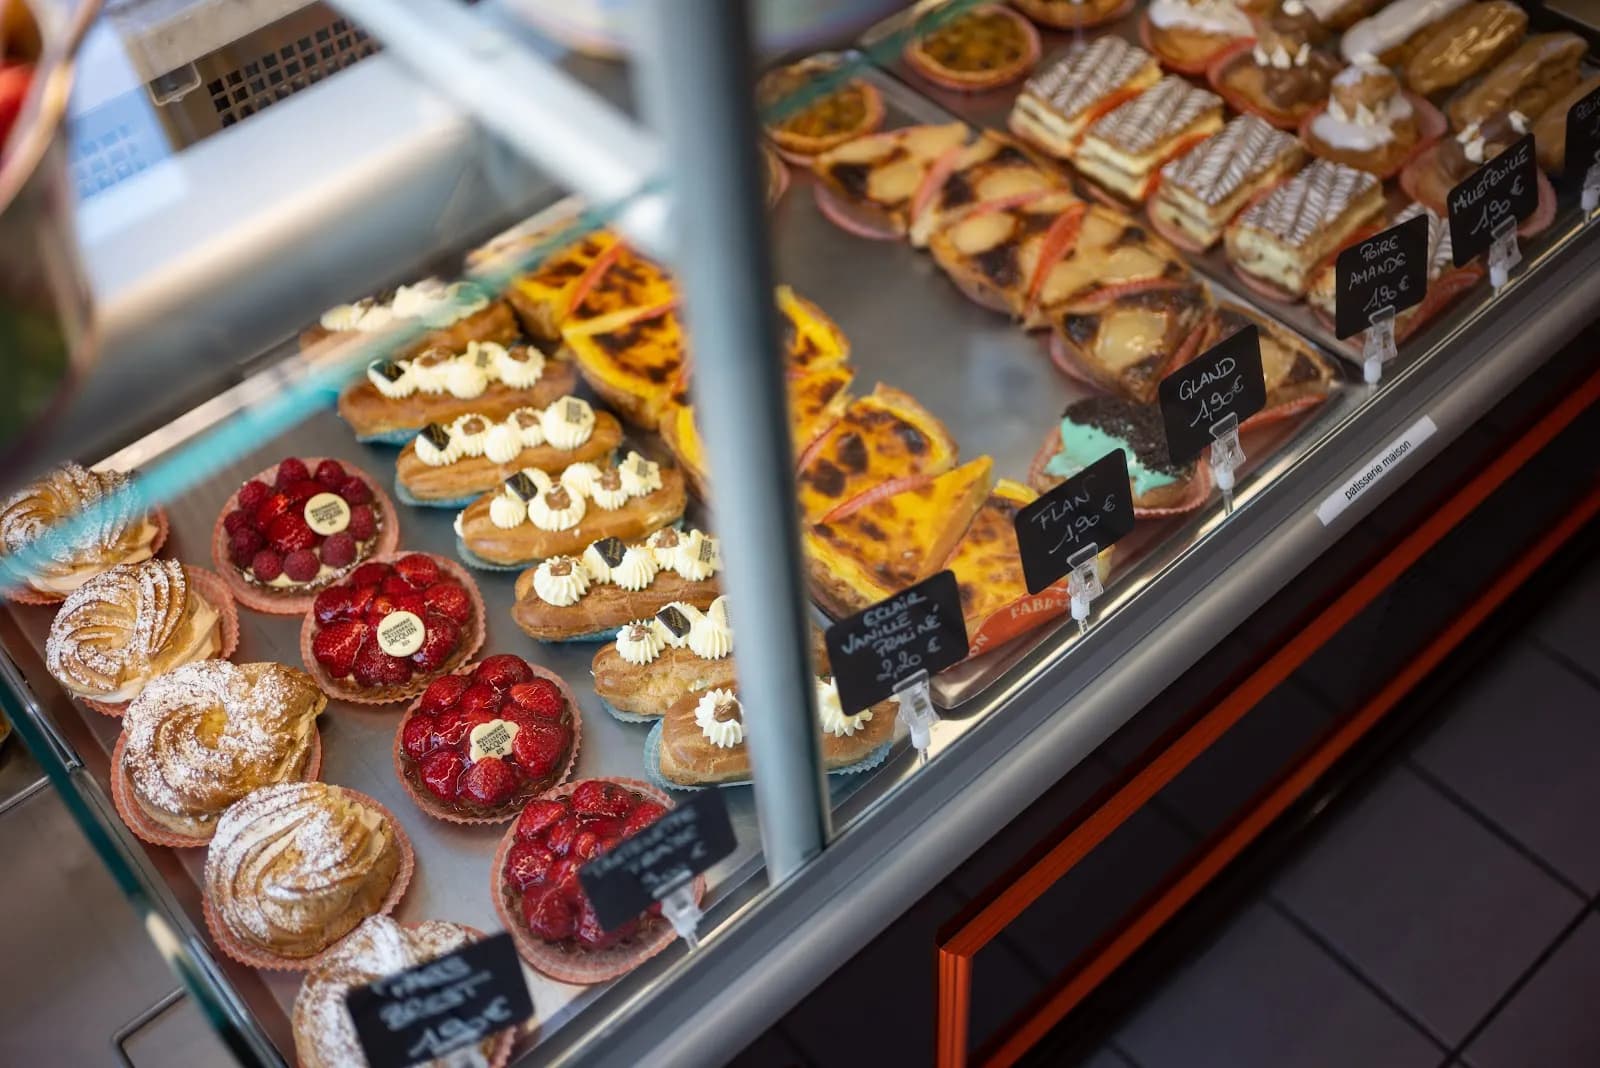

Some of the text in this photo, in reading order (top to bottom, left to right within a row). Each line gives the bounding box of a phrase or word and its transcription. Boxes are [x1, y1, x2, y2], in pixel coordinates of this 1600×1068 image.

[1510, 175, 1524, 196] €
[1360, 235, 1399, 262] POIRE
[1348, 252, 1406, 291] AMANDE
[1399, 275, 1410, 291] €
[1179, 357, 1236, 400] GLAND
[1344, 439, 1412, 501] patisserie maison
[1031, 474, 1096, 532] FLAN
[1102, 494, 1116, 512] €
[841, 611, 912, 655] VANILLE
